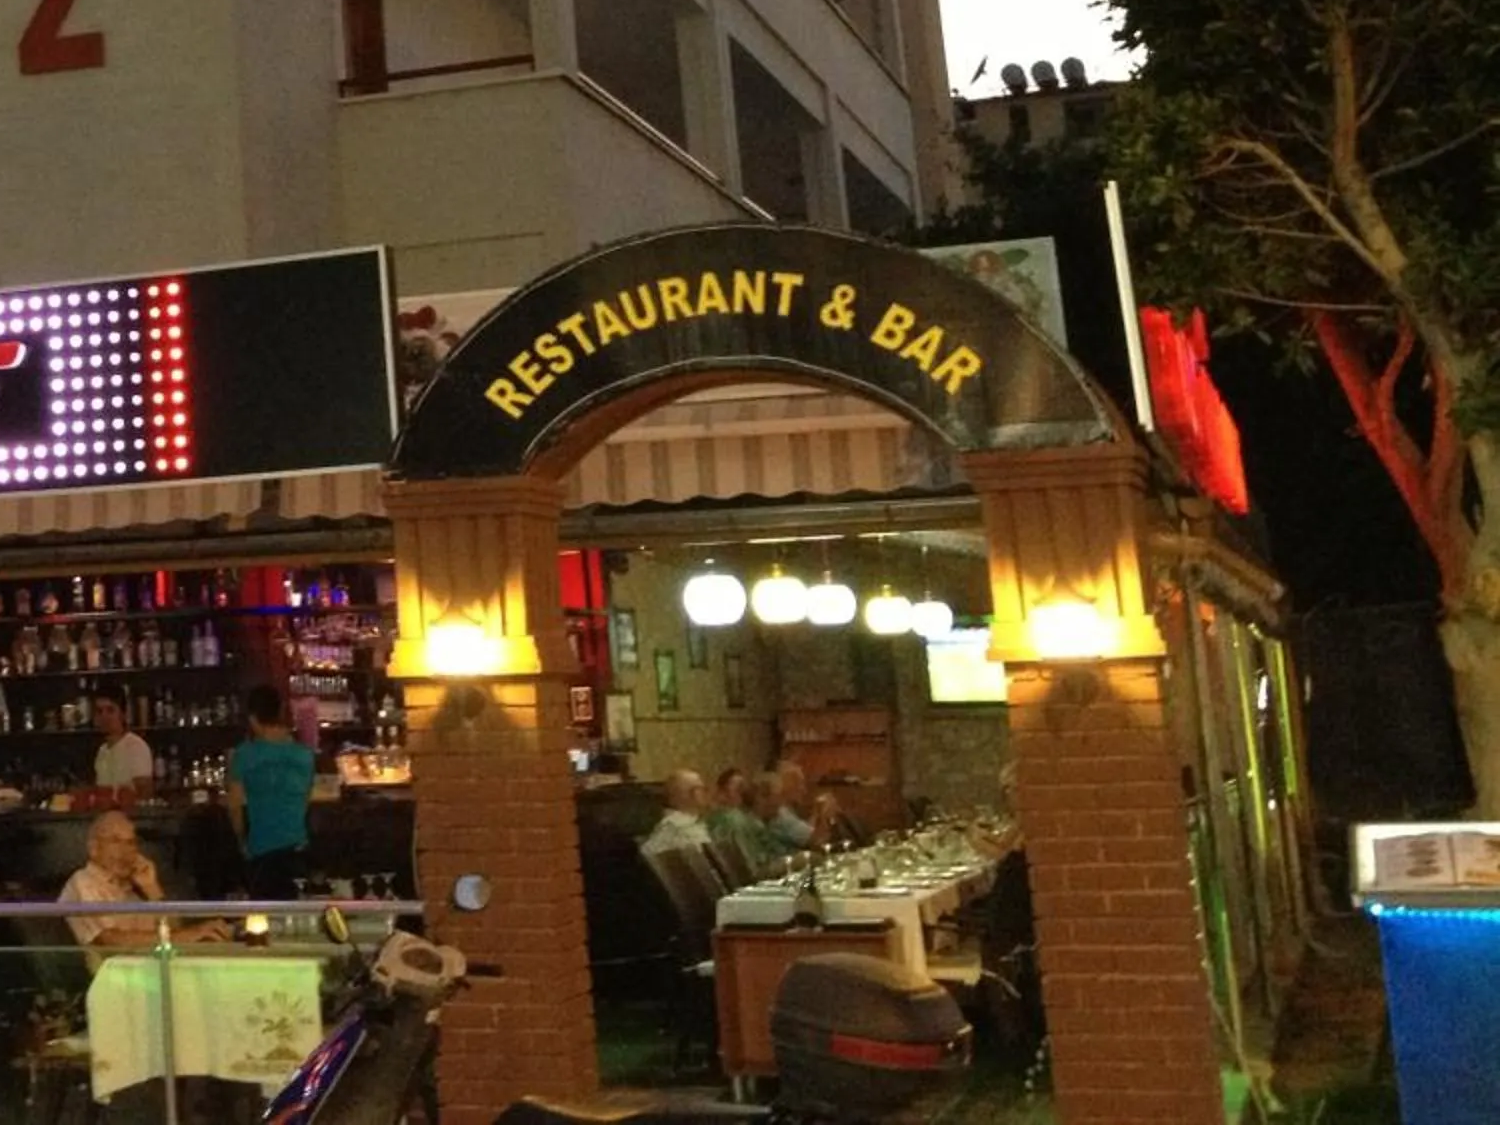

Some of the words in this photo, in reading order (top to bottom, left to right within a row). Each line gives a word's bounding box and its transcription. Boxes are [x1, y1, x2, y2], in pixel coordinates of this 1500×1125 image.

[483, 270, 803, 420] RESTAURANT
[819, 283, 855, 331] &
[869, 302, 983, 396] BAR
